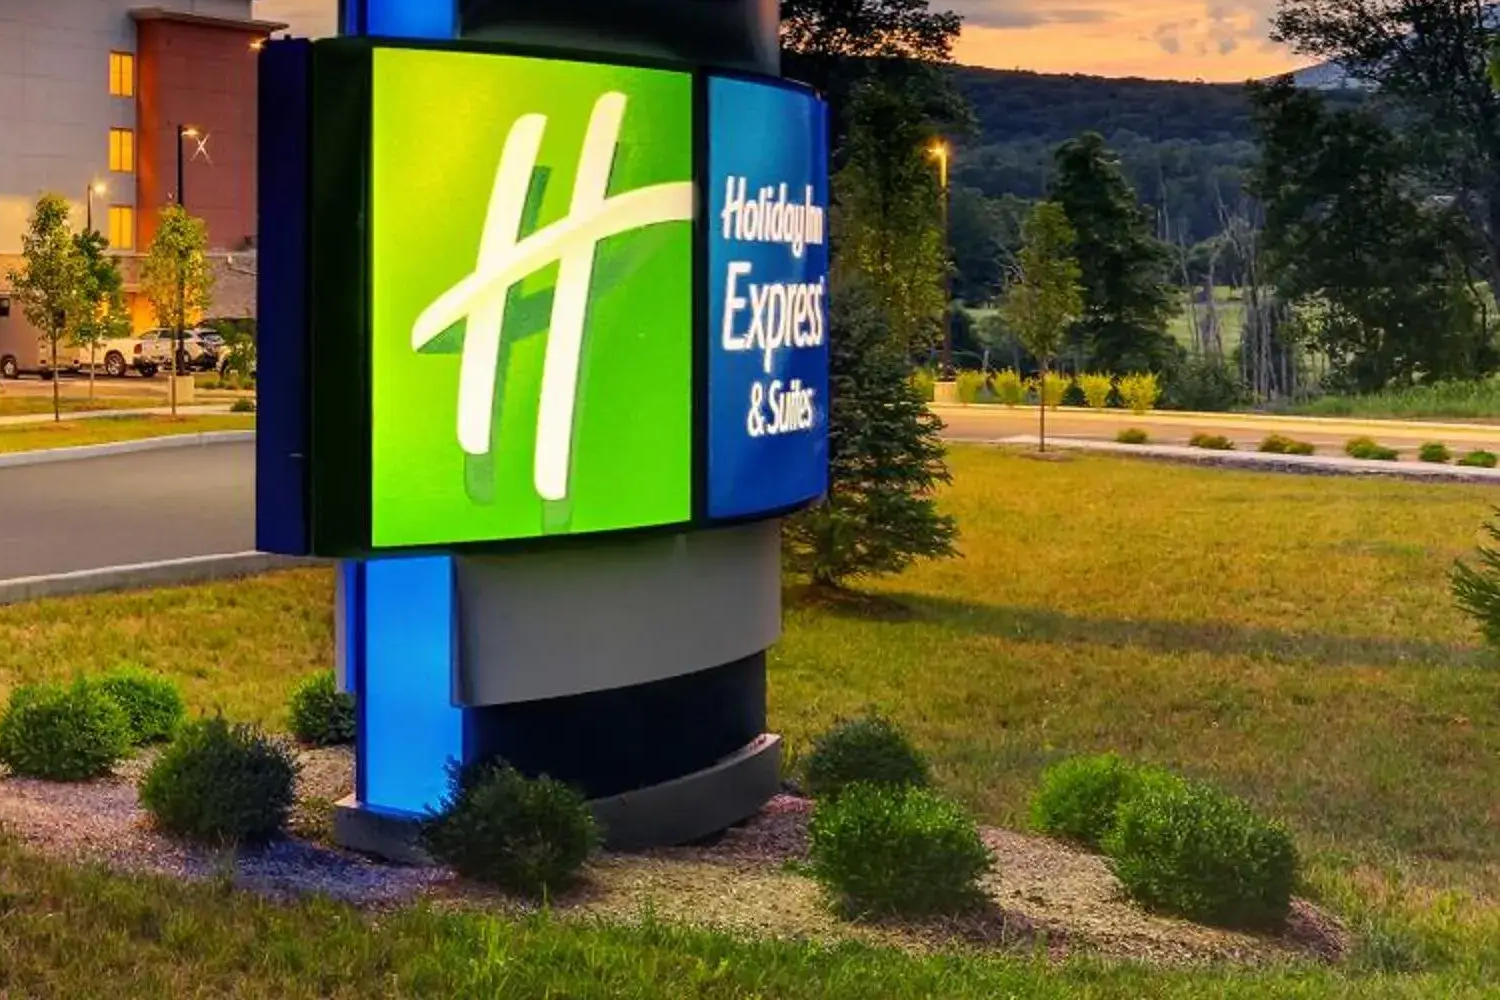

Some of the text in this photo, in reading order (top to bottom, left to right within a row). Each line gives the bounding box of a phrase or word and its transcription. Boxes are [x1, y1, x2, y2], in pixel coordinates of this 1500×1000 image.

[721, 175, 805, 258] Holiday
[722, 261, 823, 373] Express
[747, 379, 813, 437] & Suites
